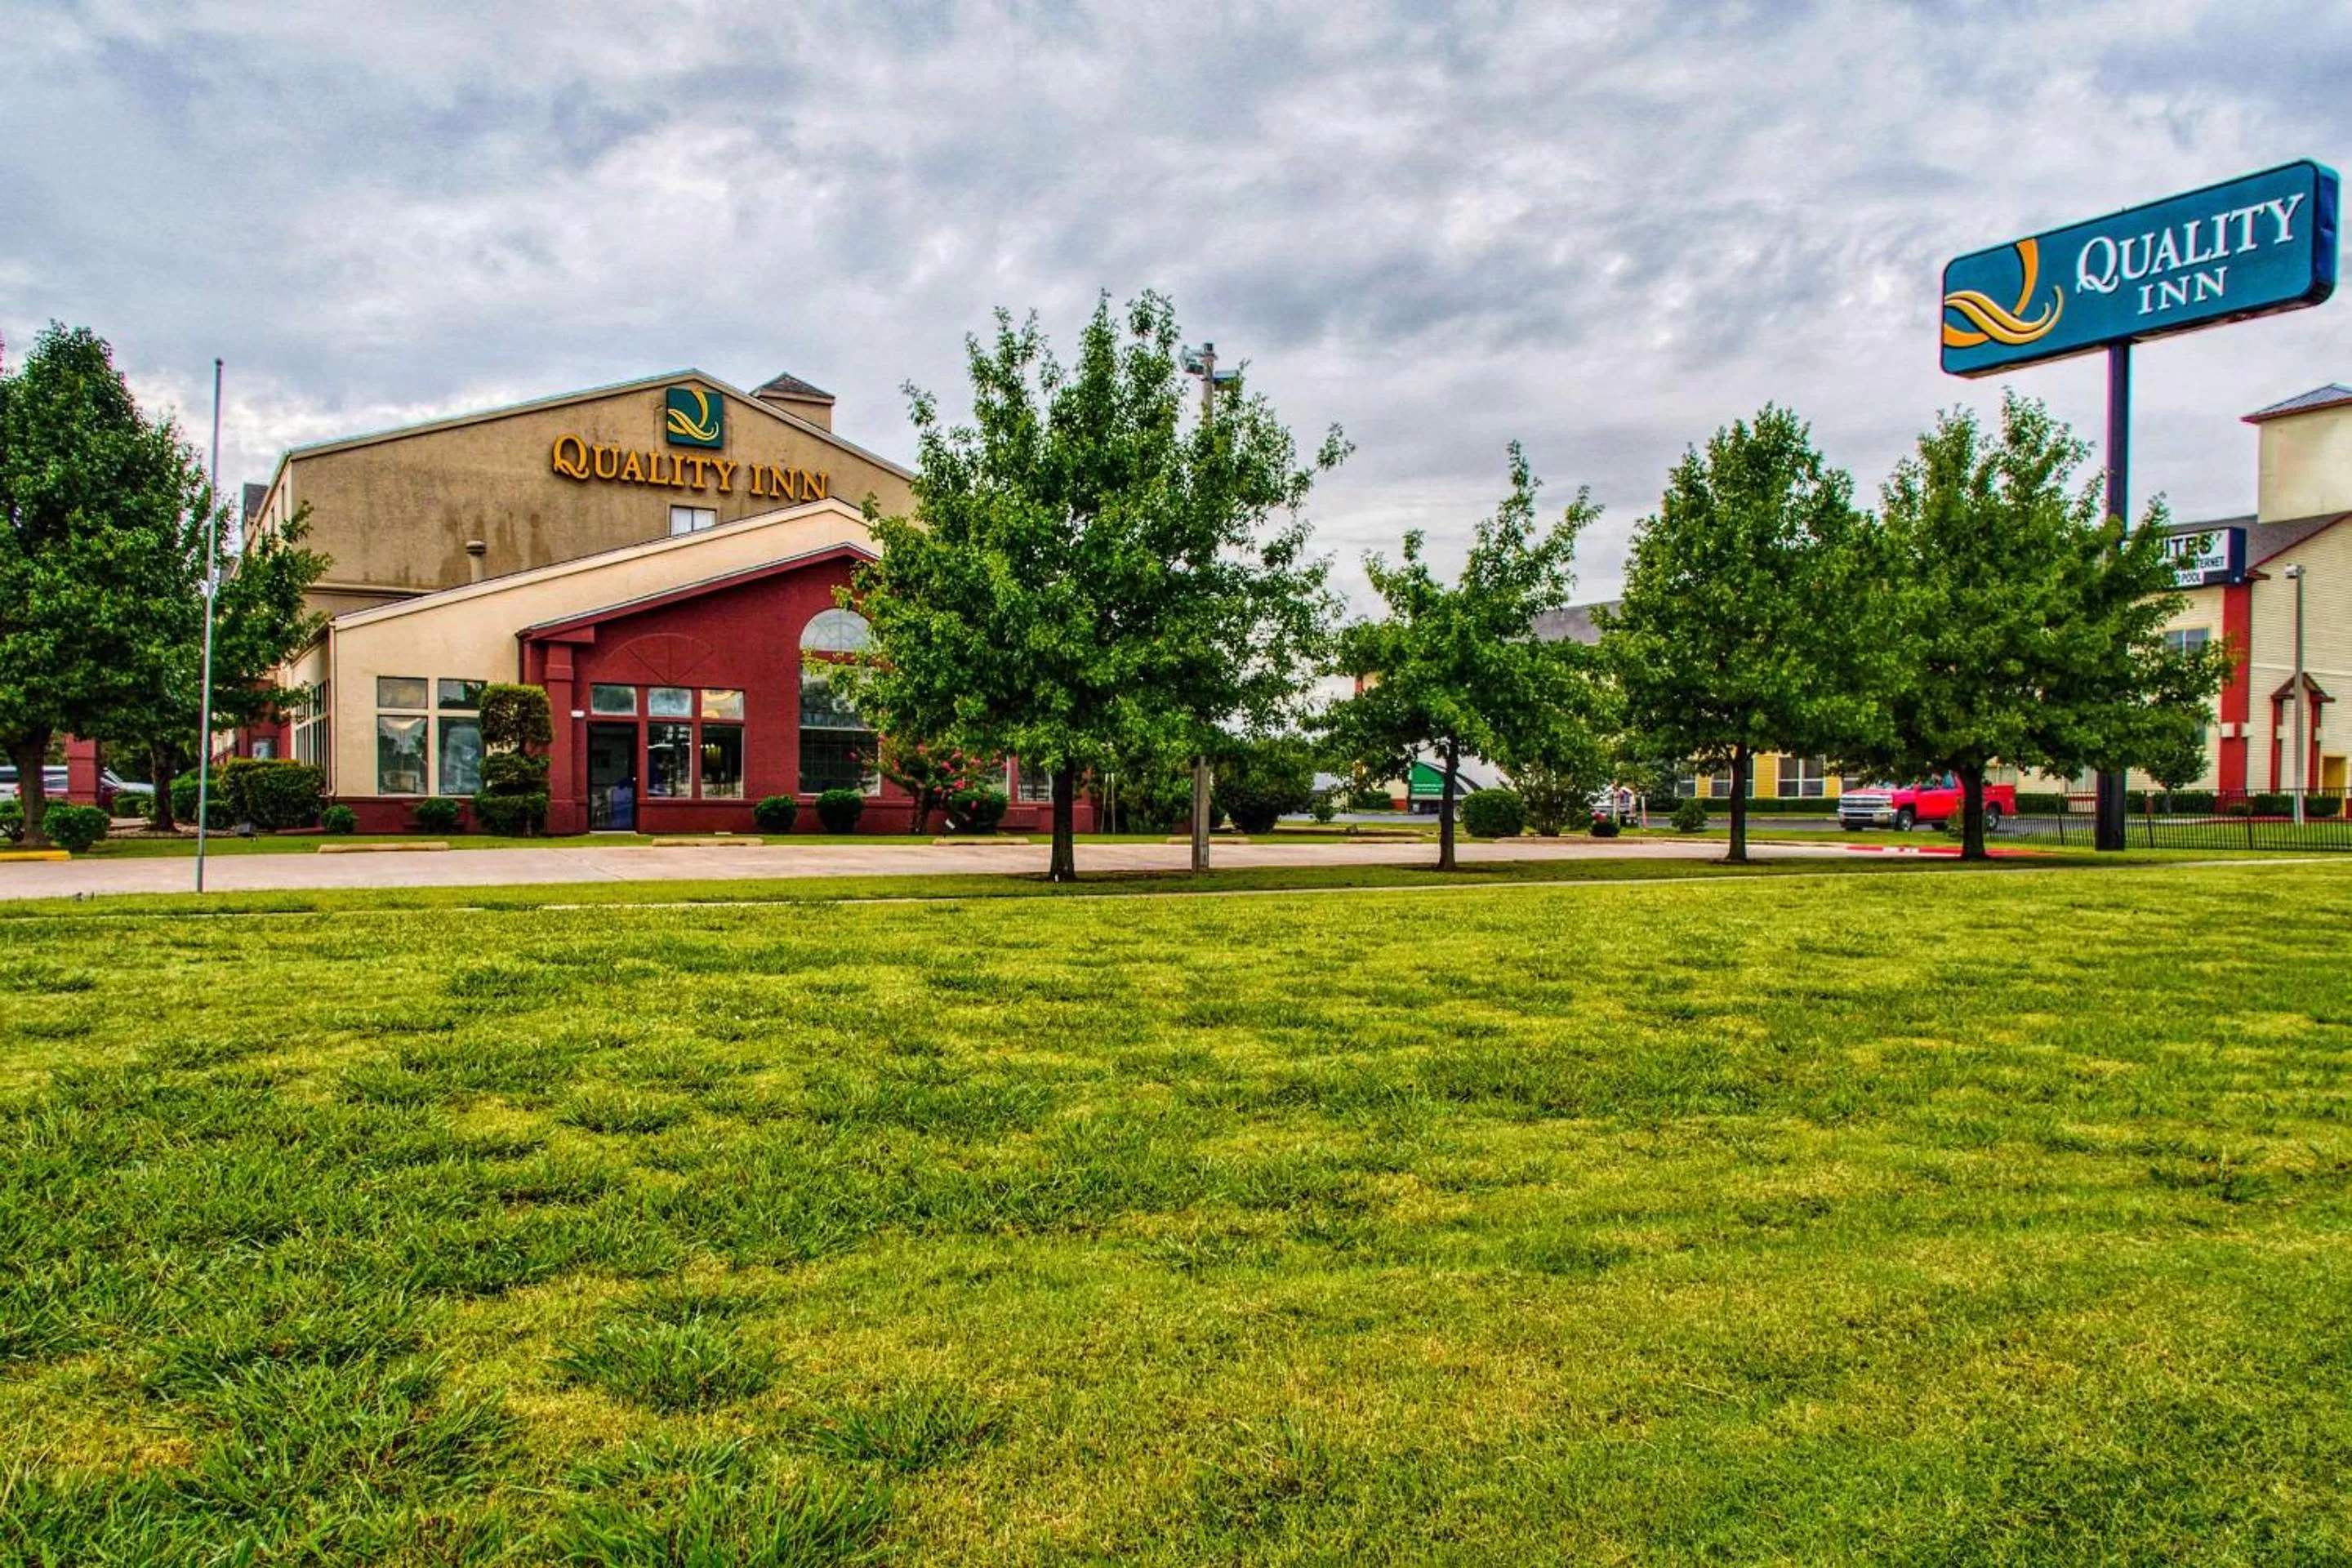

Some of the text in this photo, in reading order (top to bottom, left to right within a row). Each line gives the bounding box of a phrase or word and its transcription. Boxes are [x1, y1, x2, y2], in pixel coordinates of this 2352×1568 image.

[2076, 193, 2305, 294] QUALITY
[2138, 267, 2227, 315] INN
[553, 434, 829, 501] QUALITY INN
